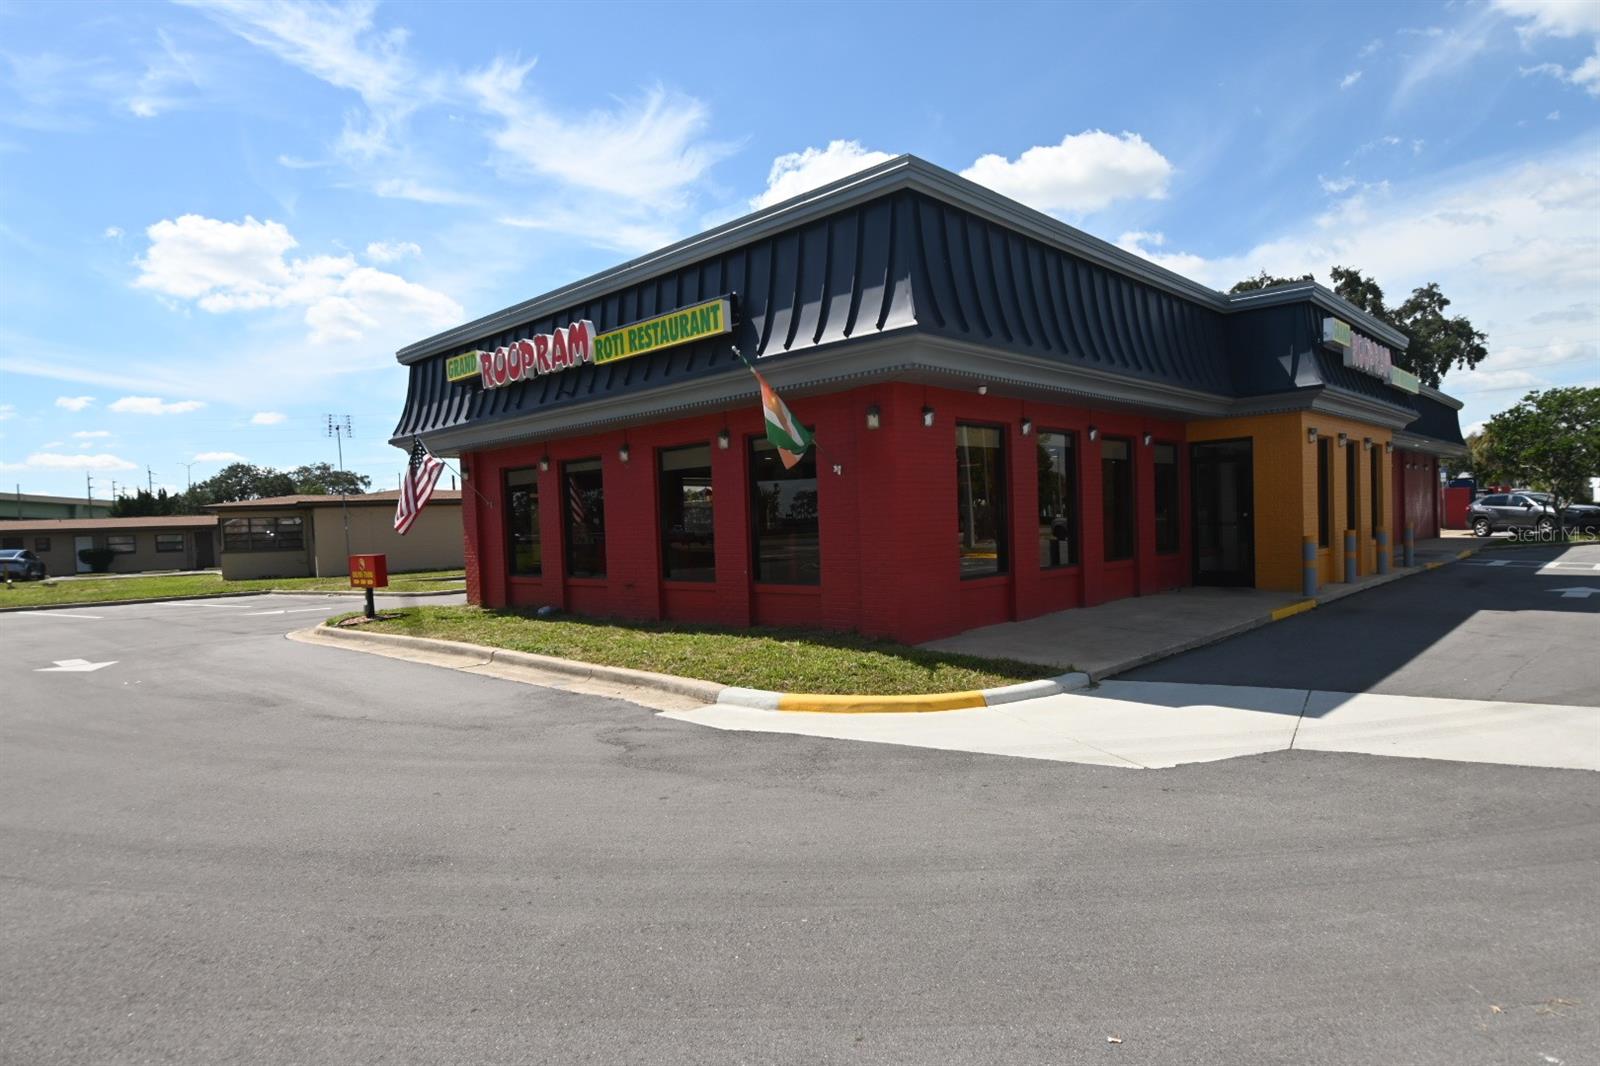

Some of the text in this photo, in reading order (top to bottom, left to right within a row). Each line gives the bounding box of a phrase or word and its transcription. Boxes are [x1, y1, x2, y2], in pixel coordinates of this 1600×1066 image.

[448, 304, 720, 389] GRAND ROOPRAM ROTI RESTAURANT
